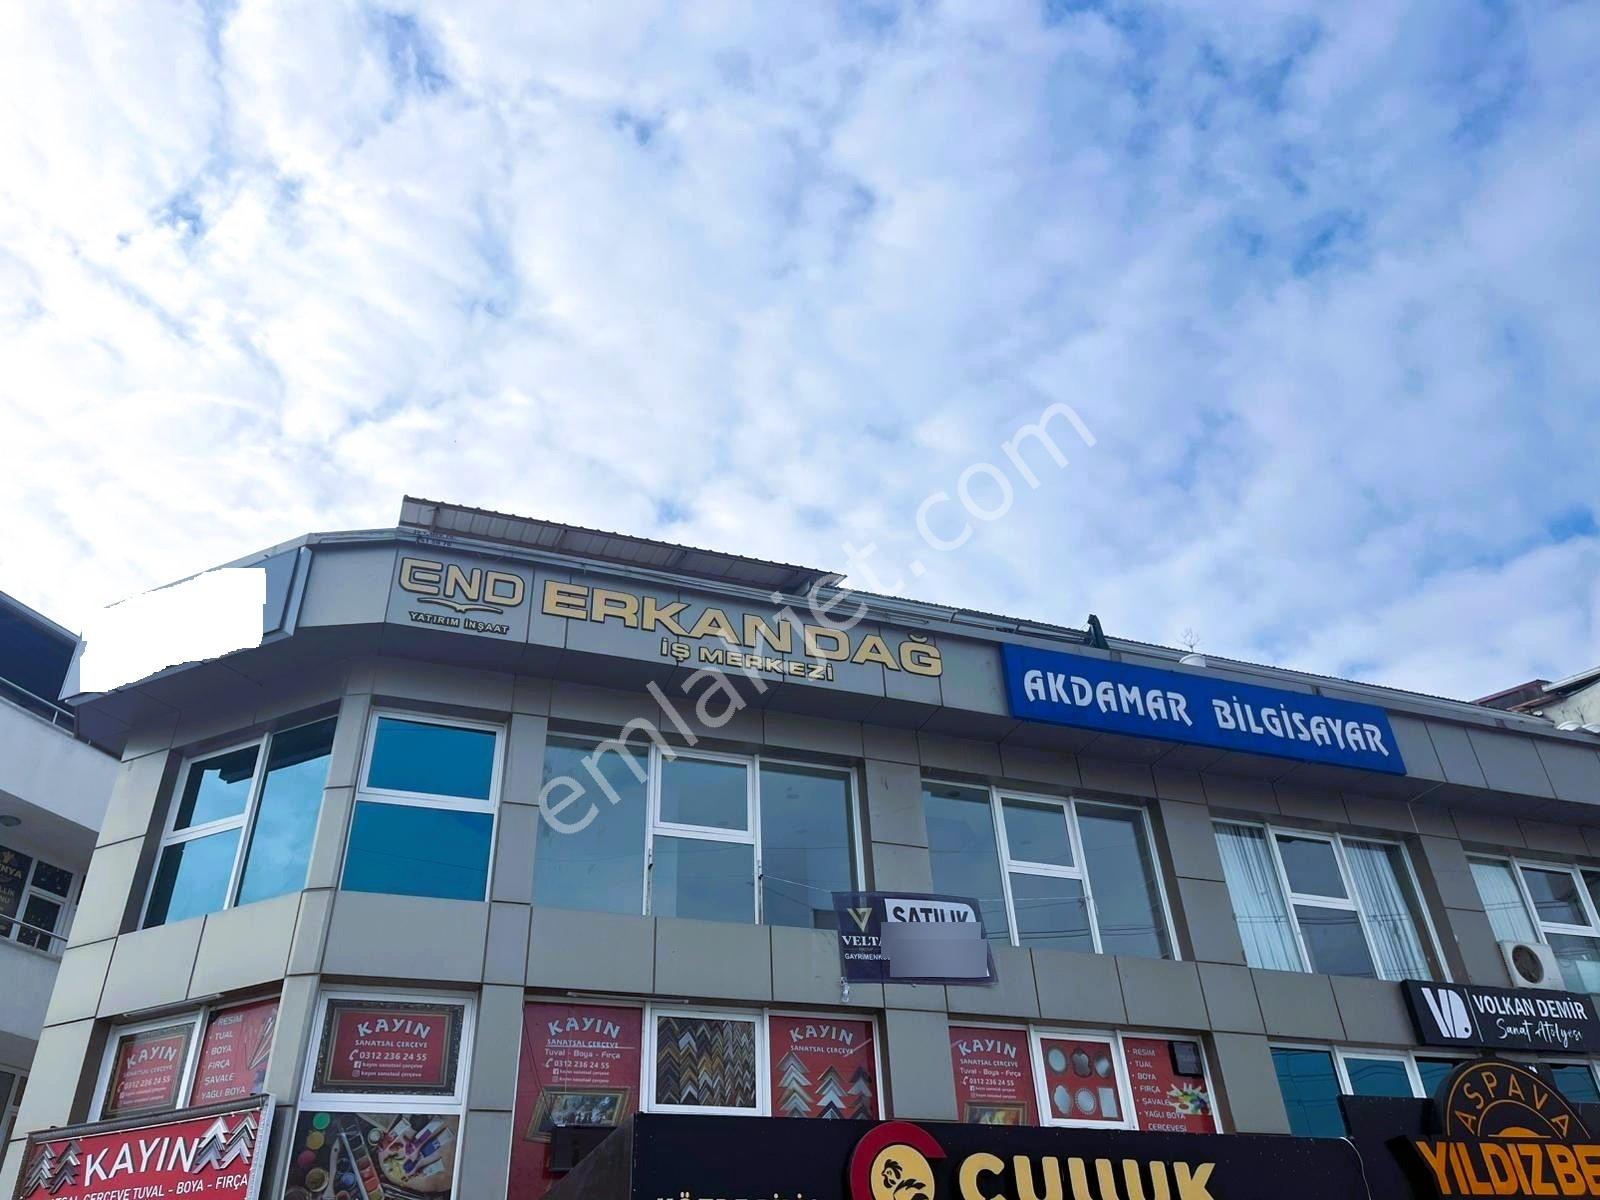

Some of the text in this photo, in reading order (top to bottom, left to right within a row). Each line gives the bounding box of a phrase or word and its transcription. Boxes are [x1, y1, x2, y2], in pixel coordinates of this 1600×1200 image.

[399, 556, 525, 608] END
[409, 611, 510, 634] YATIRIM İNŞAAT
[660, 637, 835, 681] İŞ MERKEZİ
[1023, 669, 1390, 757] AKDAMAR BİLGİSAYAR
[842, 935, 882, 947] VELT
[1472, 994, 1588, 1020] VOLKAN DEMİR
[357, 1018, 431, 1039] KAYIN
[548, 1017, 620, 1039] KAYIN
[790, 1025, 853, 1045] KAYIN
[1496, 1017, 1533, 1043] Sanat
[211, 1045, 232, 1056] BOYA
[355, 1039, 394, 1047] SANATSAL
[790, 1045, 824, 1053] SANATSAL
[958, 1039, 1016, 1059] KAYIN
[127, 1045, 177, 1070] KAYIN
[360, 1051, 428, 1061] 0312 236 24 55
[1135, 1060, 1153, 1068] TUAL
[1138, 1073, 1157, 1081] BOYA
[1455, 1071, 1569, 1138] ASPAVA
[1166, 1112, 1186, 1120] BOYA
[84, 1136, 199, 1187] KAYIN
[133, 1184, 164, 1200] TUVAL
[176, 1179, 203, 1195] BOYA
[215, 1173, 248, 1190] FIRÇA
